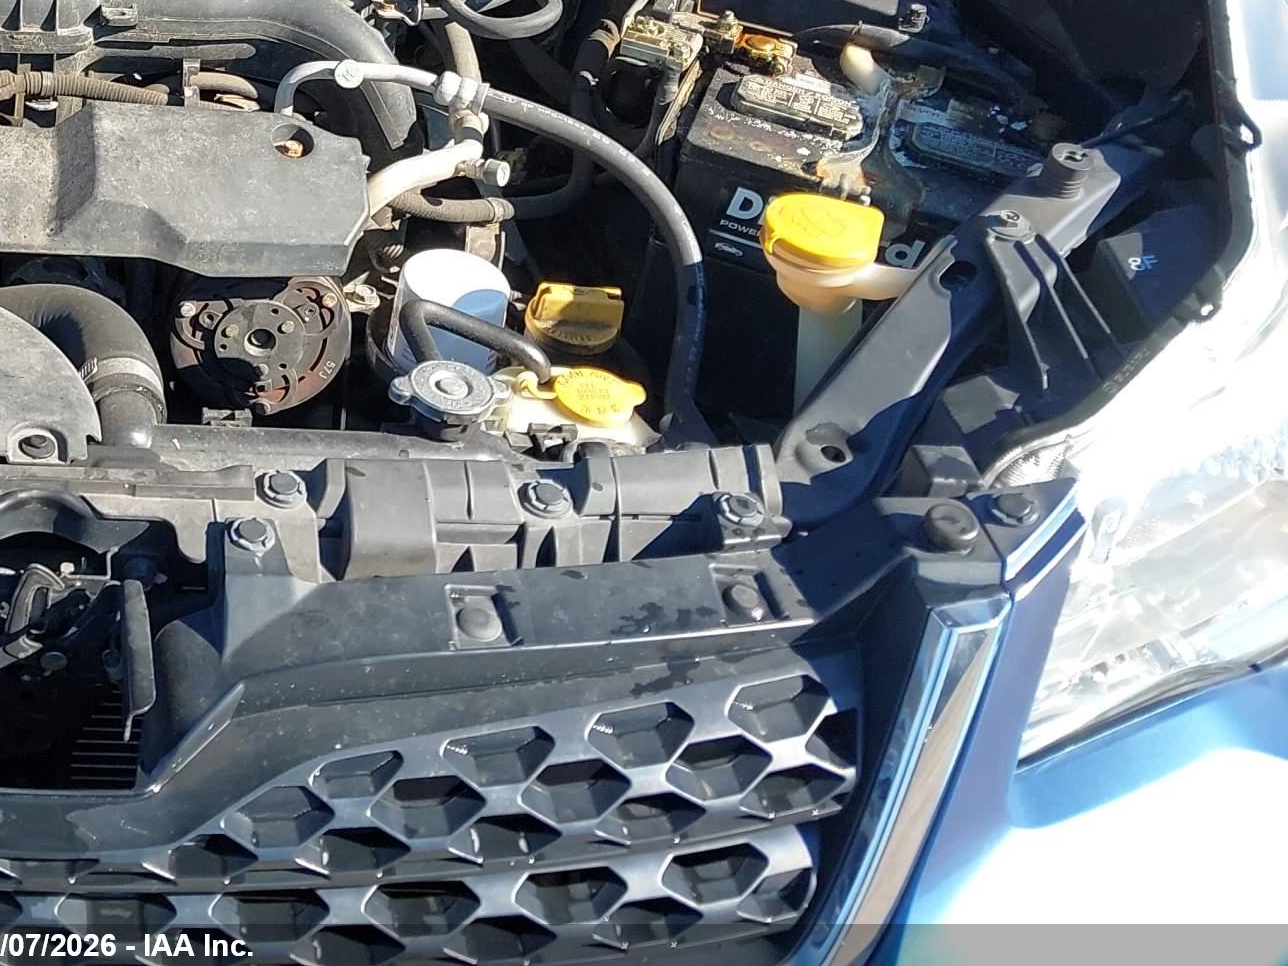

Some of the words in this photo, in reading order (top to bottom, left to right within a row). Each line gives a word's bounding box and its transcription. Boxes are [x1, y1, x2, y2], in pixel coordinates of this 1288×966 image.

[726, 187, 765, 224] D
[884, 239, 926, 269] d
[1127, 254, 1159, 271] 8F
